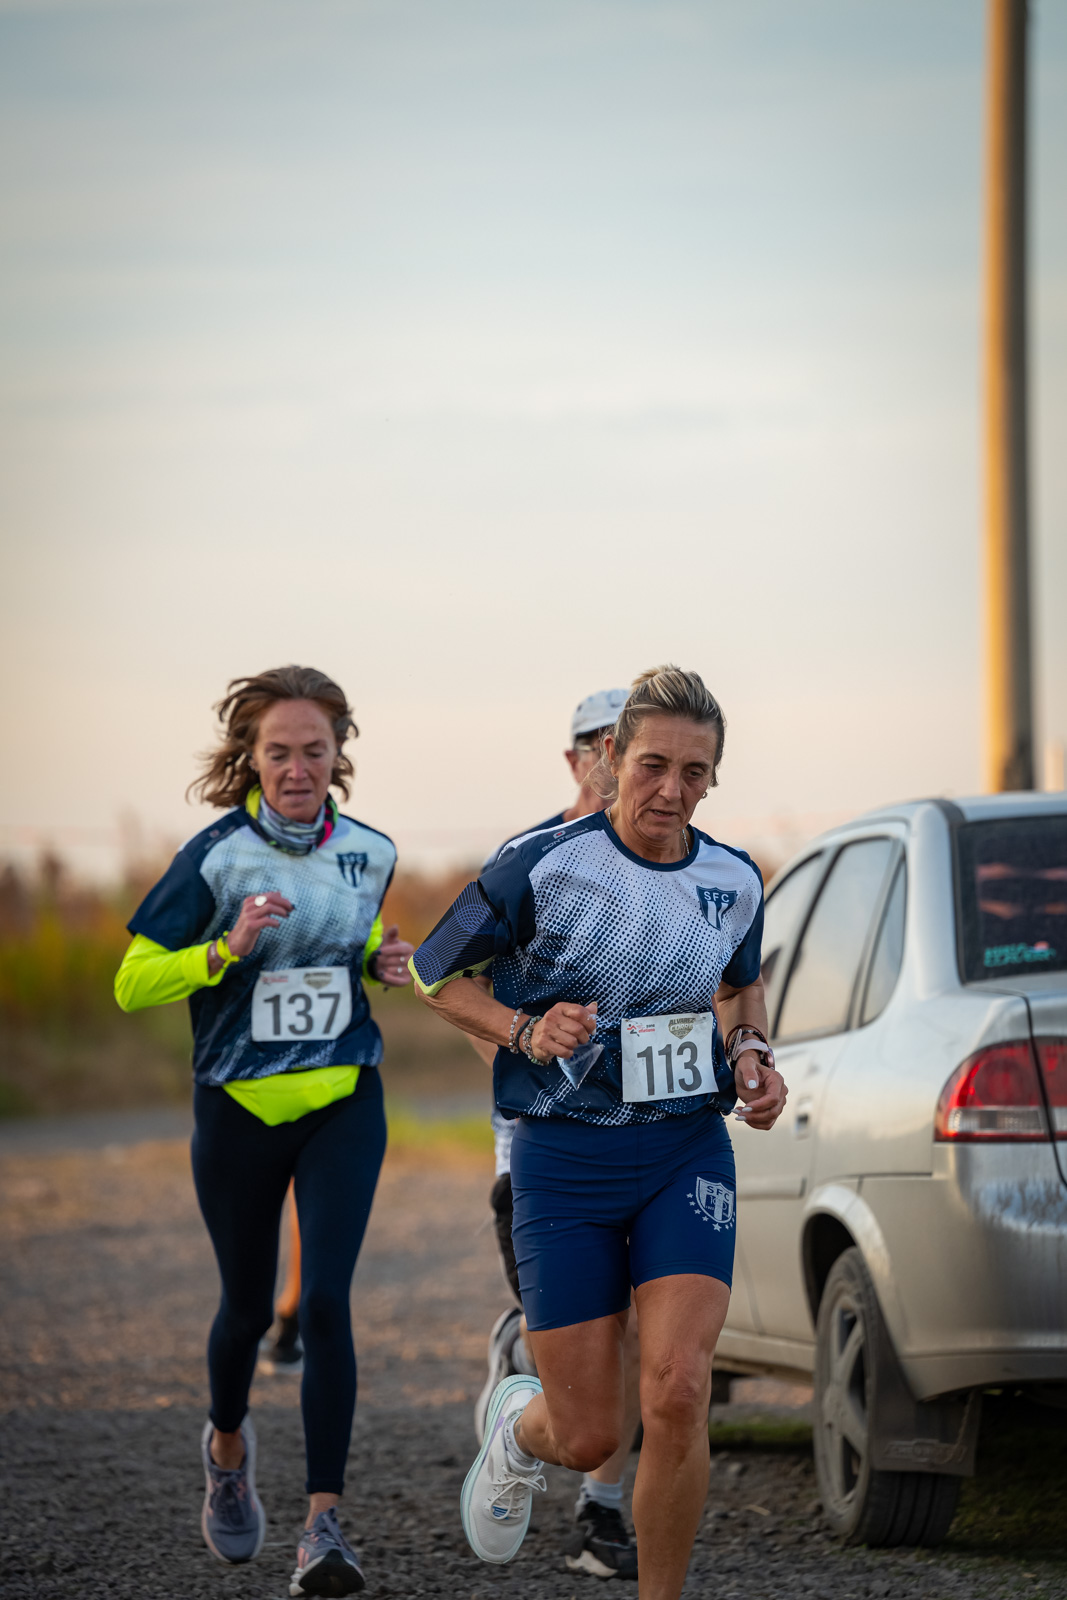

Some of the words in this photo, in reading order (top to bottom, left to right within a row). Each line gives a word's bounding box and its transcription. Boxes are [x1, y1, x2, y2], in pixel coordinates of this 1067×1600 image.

[703, 891, 730, 903] SFC
[263, 992, 341, 1036] 137
[669, 1018, 697, 1026] ALVAREZ
[637, 1041, 702, 1096] 113
[706, 1185, 730, 1202] SFC
